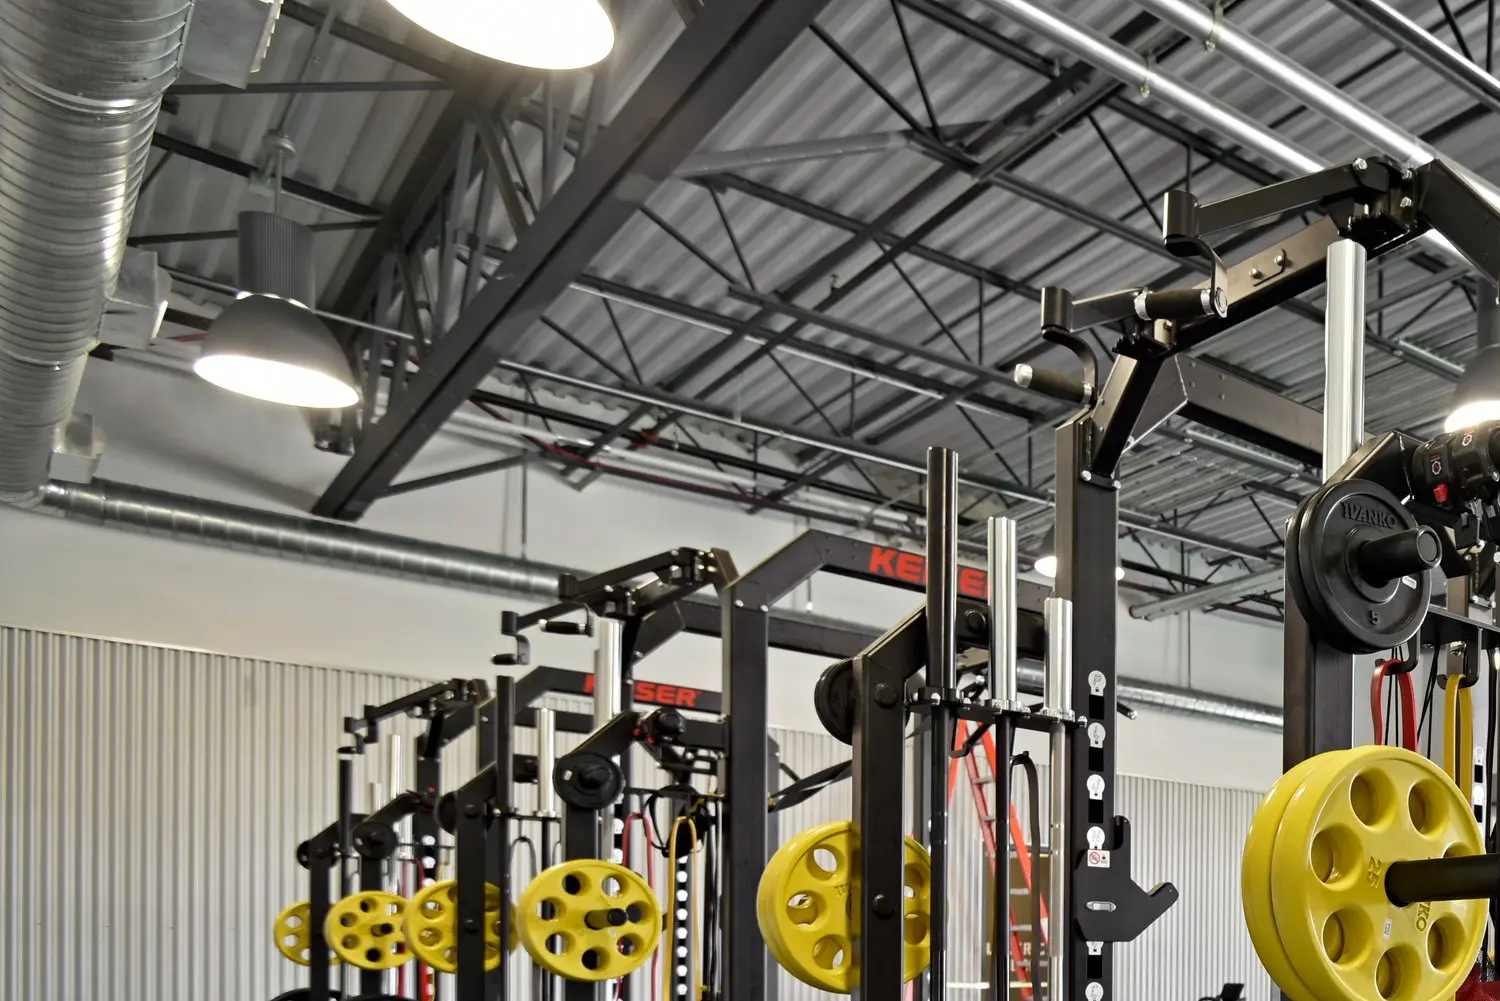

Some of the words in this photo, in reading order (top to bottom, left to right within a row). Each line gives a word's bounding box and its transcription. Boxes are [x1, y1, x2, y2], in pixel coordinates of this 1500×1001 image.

[1342, 502, 1397, 529] IVANKO
[869, 547, 989, 598] KEE
[1368, 610, 1380, 625] 5
[1367, 856, 1382, 888] 25
